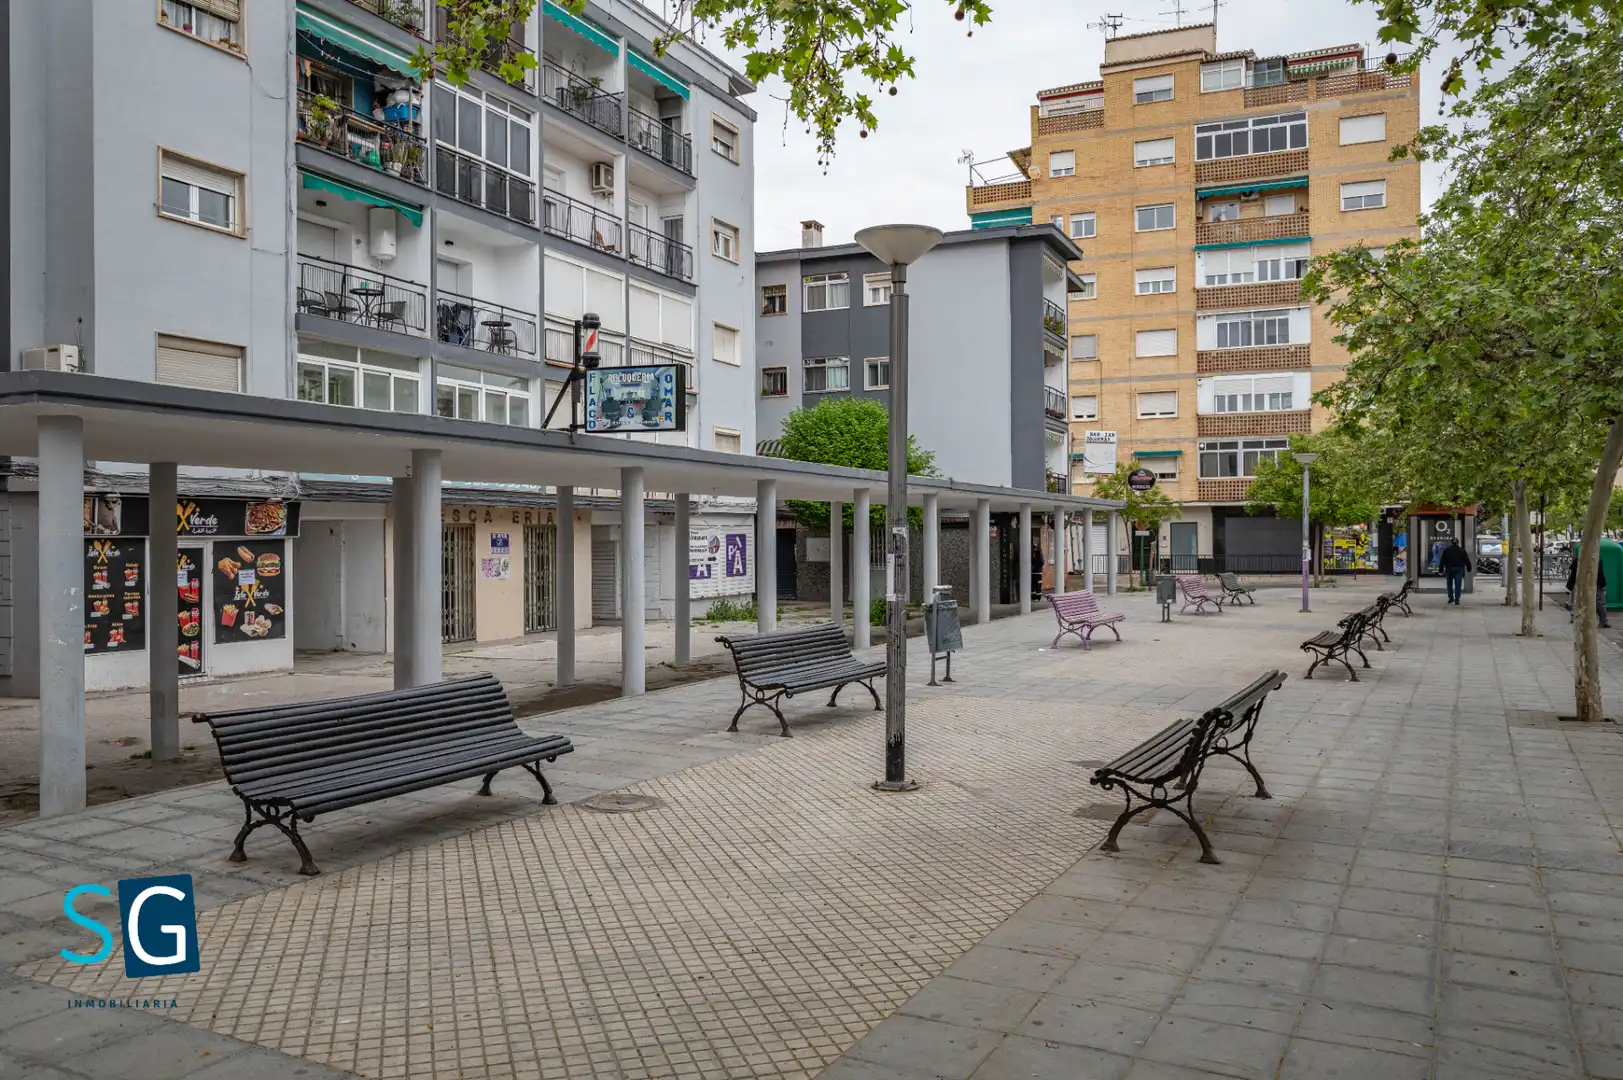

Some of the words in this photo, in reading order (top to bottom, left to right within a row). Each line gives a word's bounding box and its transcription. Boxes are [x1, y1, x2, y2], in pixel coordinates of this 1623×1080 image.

[664, 373, 673, 422] OMAR
[627, 407, 635, 418] &
[190, 512, 218, 525] Verde
[254, 589, 270, 597] Verde
